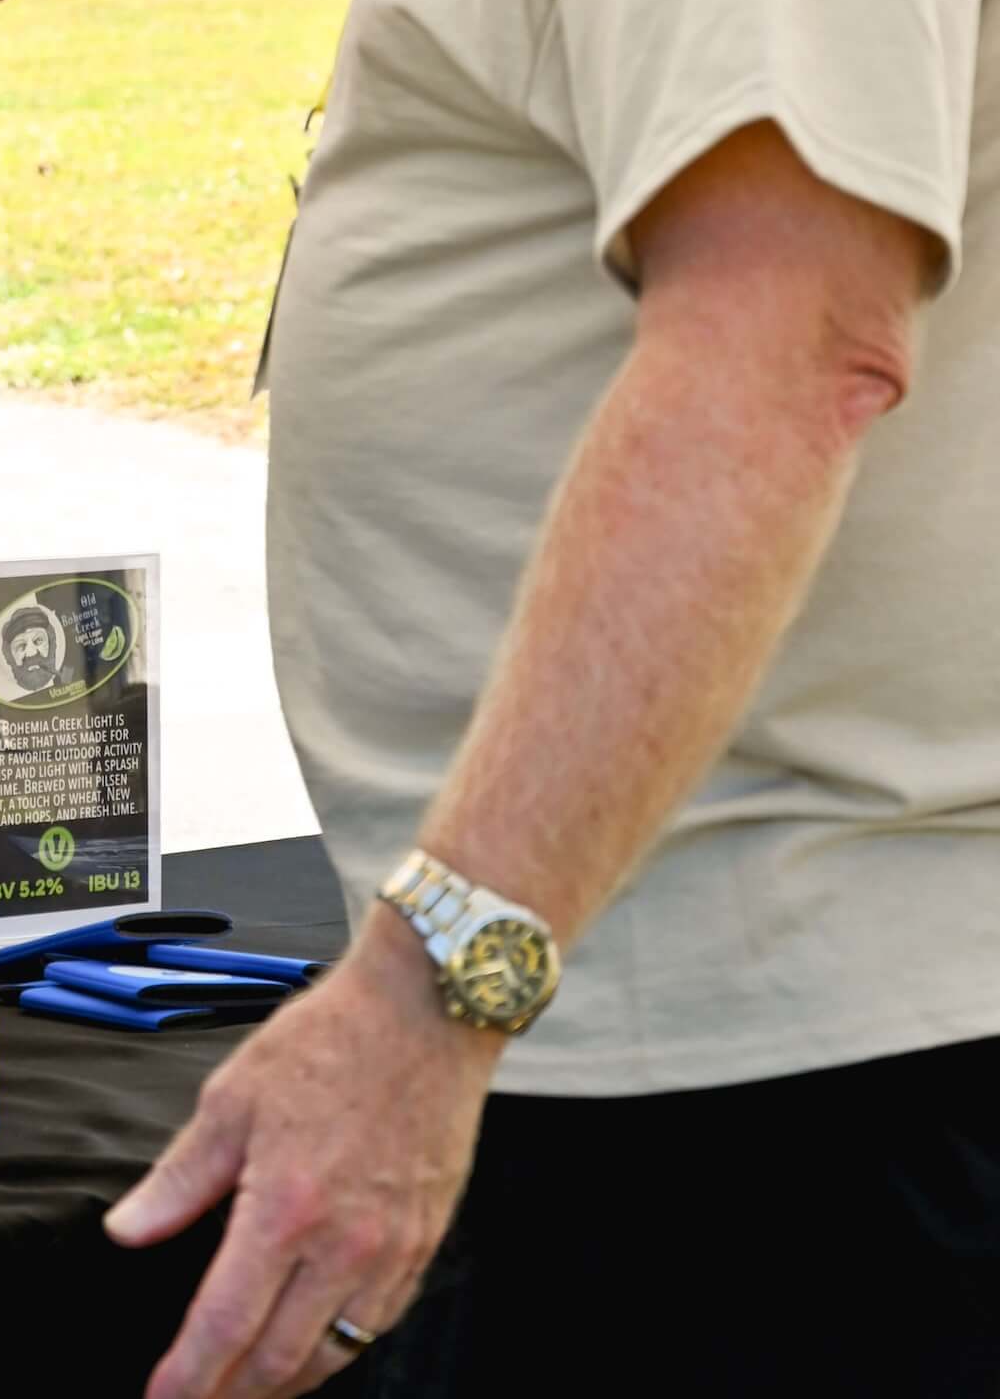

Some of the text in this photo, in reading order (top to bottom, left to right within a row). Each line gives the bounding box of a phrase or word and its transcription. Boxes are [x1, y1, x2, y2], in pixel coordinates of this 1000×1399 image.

[2, 720, 49, 736] BOHEMIA
[52, 716, 83, 732] CREEK
[85, 714, 112, 729] LIGHT
[115, 714, 125, 726] IS
[0, 737, 28, 751] LAGER
[32, 735, 54, 749] THAT
[56, 733, 77, 746] WAS
[80, 730, 107, 744] MADE
[110, 729, 129, 741] FOR
[8, 750, 52, 765] FAVORITE
[55, 747, 101, 762] OUTDOOR
[103, 742, 143, 757] ACTIVITY
[15, 767, 36, 779] AND
[39, 764, 66, 777] LIGHT
[68, 761, 93, 774] WITH
[96, 761, 102, 772] A
[105, 757, 139, 772] SPLASH
[24, 779, 65, 793] BREWED
[67, 776, 93, 790] WITH
[95, 774, 128, 787] PILSEN
[8, 799, 15, 809] A
[17, 795, 50, 809] TOUCH
[53, 794, 66, 806] OF
[69, 791, 104, 806] WHEAT,
[107, 787, 131, 801] NEW
[24, 810, 54, 824] HOPS,
[56, 808, 77, 821] AND
[79, 804, 110, 819] FRESH
[112, 802, 138, 816] LIME.
[19, 877, 64, 898] 5.2%
[88, 872, 119, 892] IBU
[123, 871, 140, 889] 13
